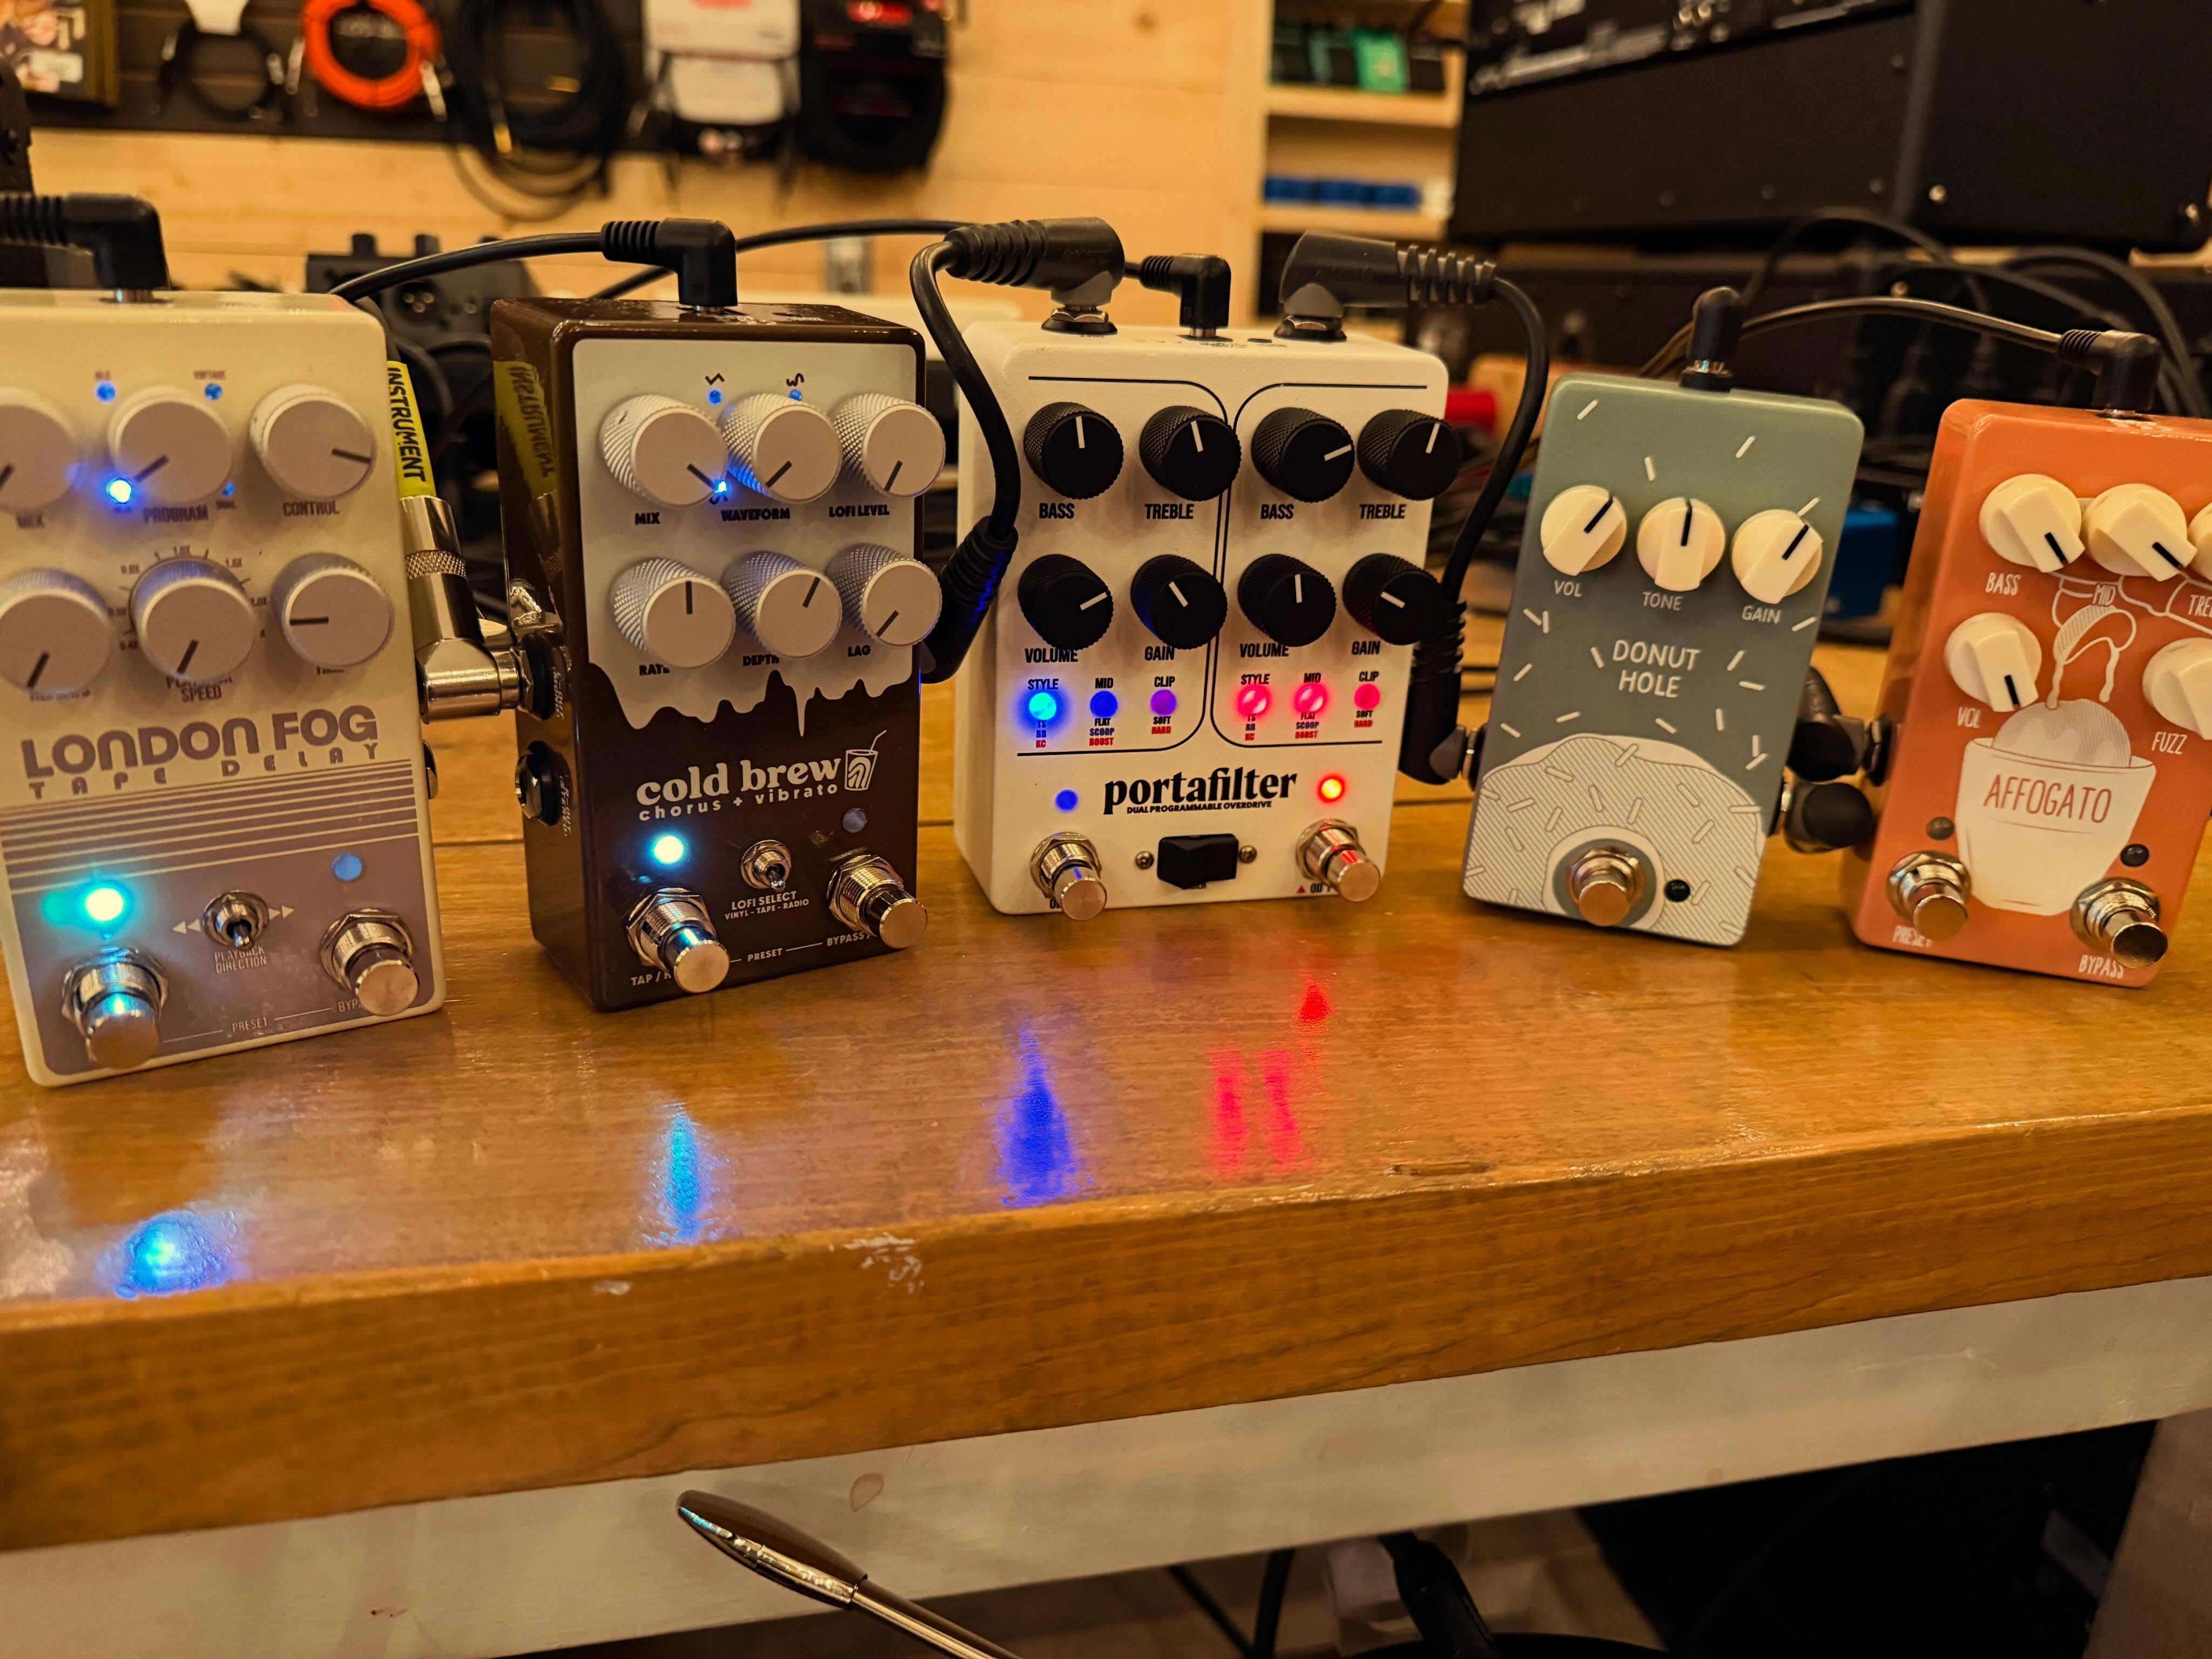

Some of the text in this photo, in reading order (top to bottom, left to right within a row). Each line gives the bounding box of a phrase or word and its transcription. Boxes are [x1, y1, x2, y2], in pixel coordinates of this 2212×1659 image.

[388, 367, 426, 482] INSTRUMENT
[143, 504, 209, 523] PROGRAM
[283, 501, 340, 517] CONTROL
[721, 508, 790, 522] WAVEFORM
[829, 505, 889, 517] LOFI LEVEL
[1038, 503, 1075, 519] BASS
[1145, 503, 1193, 520] TREBLE
[1260, 504, 1293, 520] BASS
[1360, 504, 1405, 520] TREBLE
[635, 513, 660, 524] MIX
[1554, 581, 1582, 597] VOL
[1985, 572, 2021, 596] BASS
[1643, 592, 1682, 611] TONE
[2092, 584, 2116, 606] MID
[1742, 605, 1781, 624] GAIN
[2188, 595, 2212, 618] TRE
[848, 645, 871, 657] LAG
[1025, 648, 1078, 663] VOLUME
[1144, 646, 1175, 660] GAIN
[1240, 643, 1289, 657] VOLUME
[1352, 640, 1380, 655] GAIN
[1612, 640, 1700, 670] DONUT
[743, 654, 779, 666] DEPTH
[1028, 679, 1058, 690] STYLE
[1095, 678, 1114, 689] MID
[1154, 676, 1175, 687] CLIP
[1240, 674, 1270, 685] STYLE
[1304, 673, 1321, 683] MID
[1359, 671, 1379, 682] CLIP
[1618, 671, 1681, 698] HOLE
[181, 684, 221, 702] SPEED
[1153, 716, 1171, 724] SOFT
[1356, 710, 1373, 718] SOFT
[1957, 706, 1981, 729] VOL
[1089, 728, 1115, 736] SCOOP
[1151, 726, 1171, 734] HARD
[1295, 731, 1318, 739] BOOST
[21, 705, 378, 779] LONDON FOG
[1089, 738, 1114, 746] BOOST
[2151, 731, 2188, 754] FUZZ
[29, 742, 377, 799] TAPE DELAY
[637, 758, 841, 806] cold brew
[1103, 766, 1297, 815] portafilter
[639, 784, 838, 821] chorus + vibrato
[1984, 774, 2112, 824] AFFOGATO
[1127, 801, 1272, 814] DUAL PROGRAMMABLE OVERDRIVE
[732, 891, 797, 911] LOFI SELECT
[725, 909, 748, 920] VINYL
[757, 905, 775, 915] TAPE
[783, 899, 809, 909] RADIO
[827, 932, 864, 946] BYPASS
[748, 948, 783, 962] PRESET
[216, 956, 267, 974] DIRECTION
[2078, 954, 2124, 979] BYPASS
[631, 974, 652, 986] TAP
[339, 1000, 361, 1013] BYP
[232, 1017, 267, 1033] PRESET
